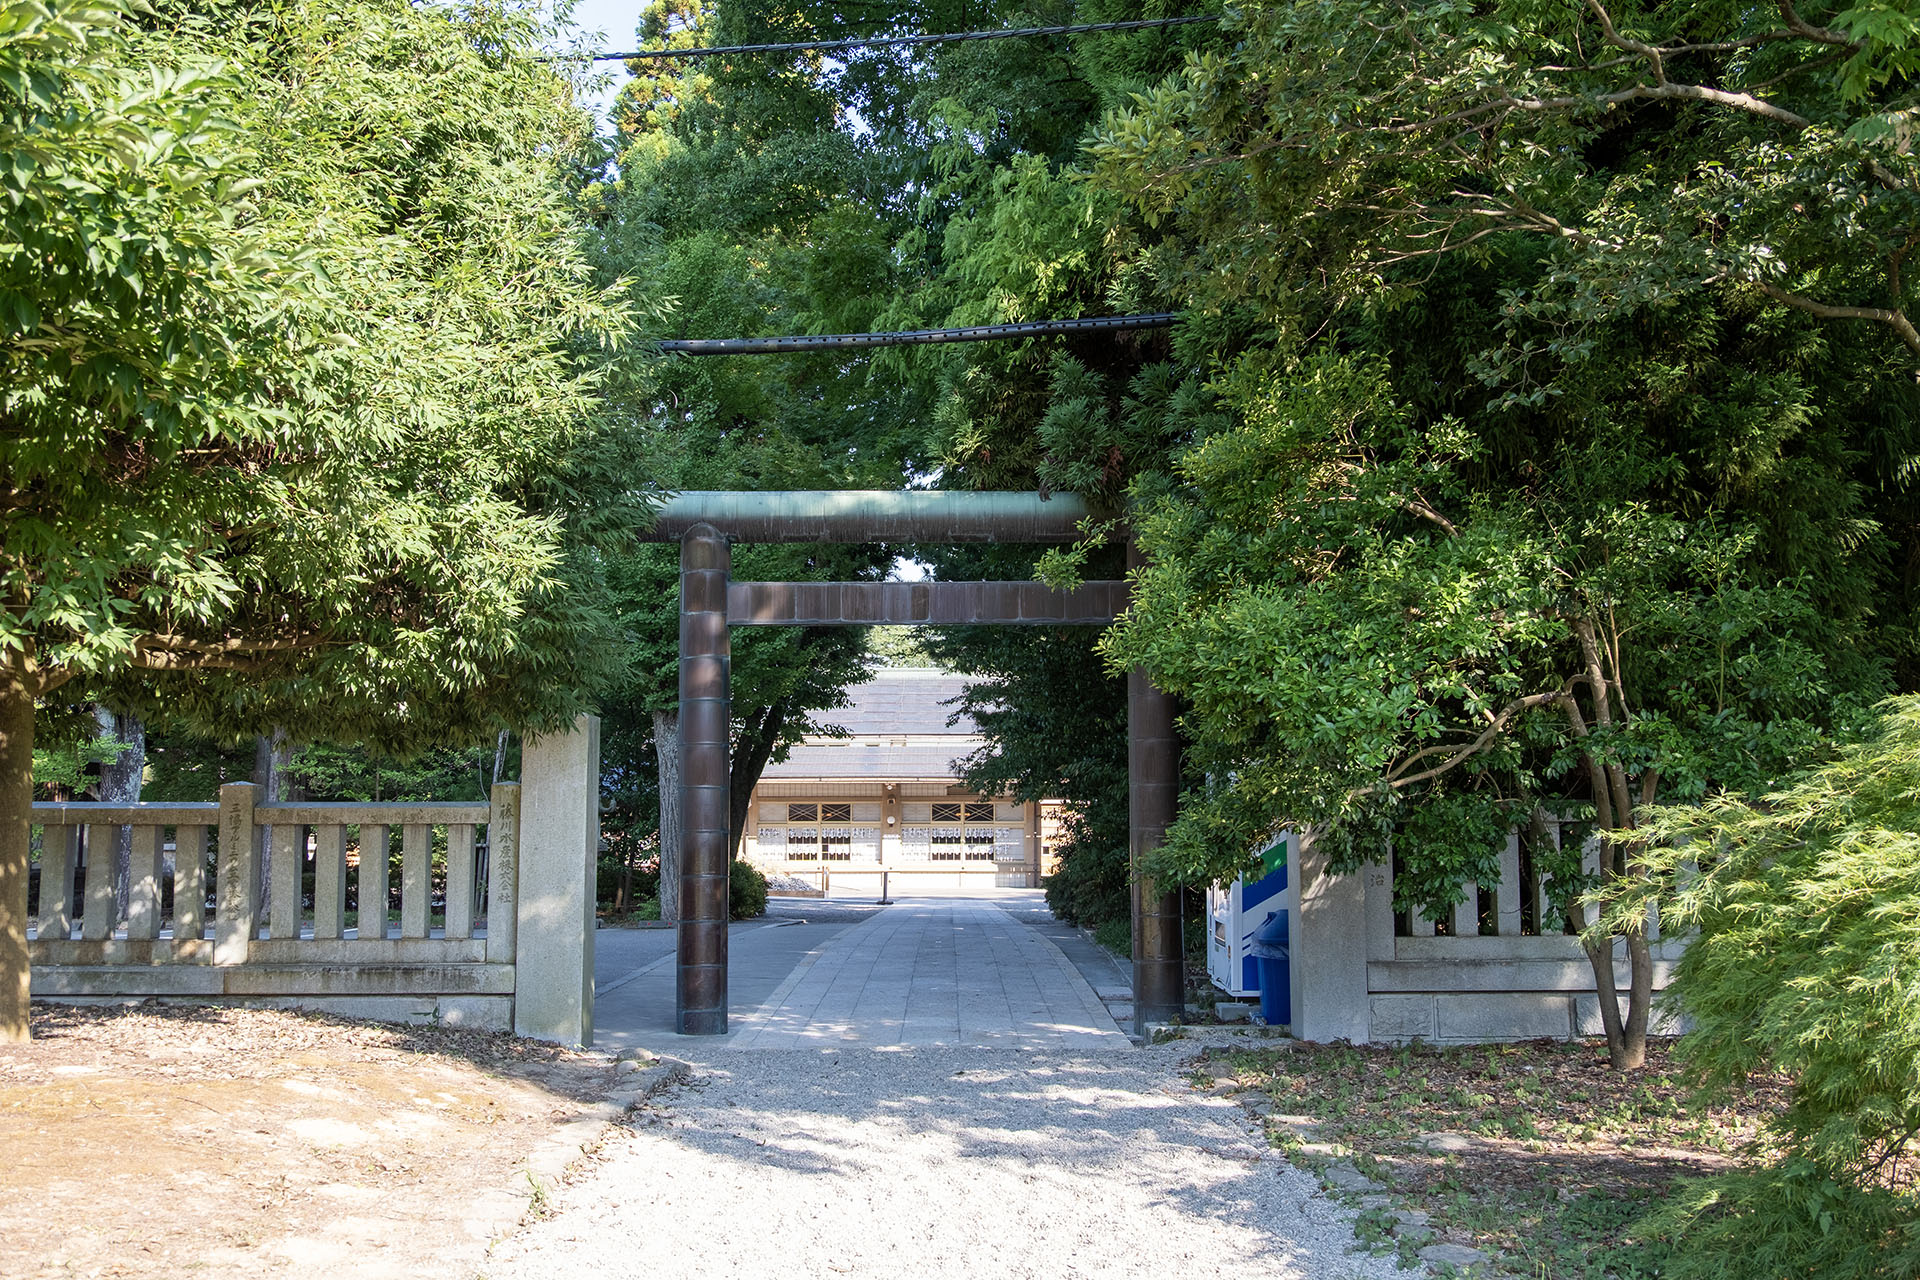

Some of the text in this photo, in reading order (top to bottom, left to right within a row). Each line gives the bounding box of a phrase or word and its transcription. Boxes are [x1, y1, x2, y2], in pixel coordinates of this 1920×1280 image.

[498, 803, 514, 903] 藤川水産株式会社
